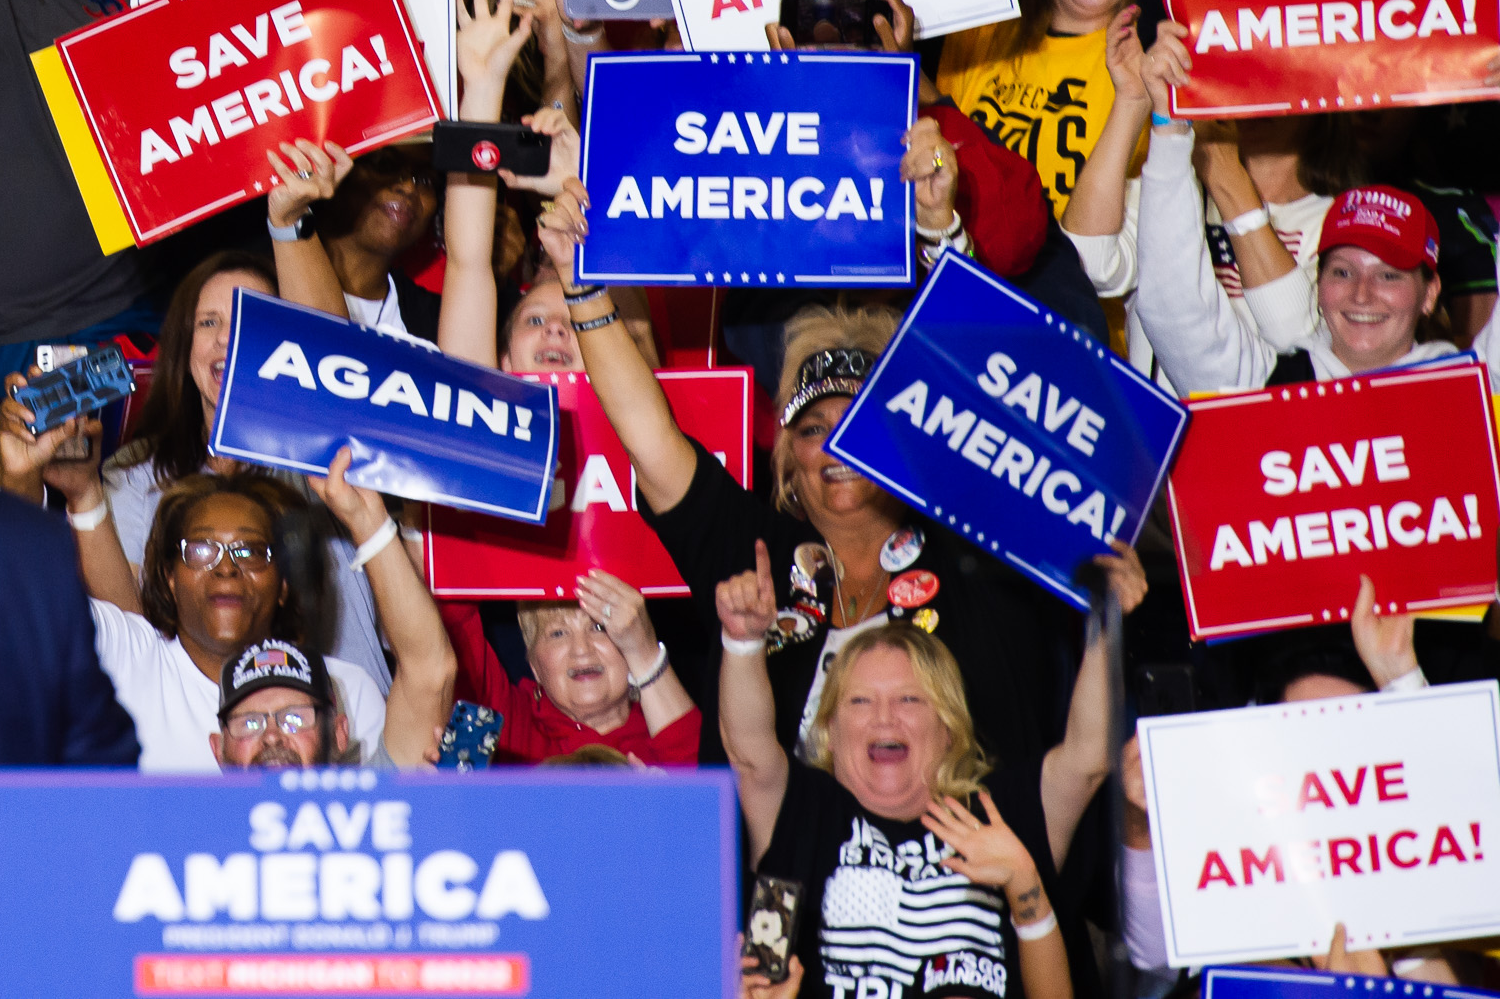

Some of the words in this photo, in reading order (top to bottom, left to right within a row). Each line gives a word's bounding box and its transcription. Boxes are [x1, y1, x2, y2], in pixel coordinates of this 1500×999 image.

[169, 0, 312, 90] SAVE
[139, 33, 395, 175] AMERICA!
[674, 111, 820, 155] SAVE
[606, 177, 885, 221] AMERICA!
[257, 339, 533, 442] AGAIN!
[977, 350, 1106, 456] SAVE
[886, 380, 1127, 545] AMERICA!
[1259, 435, 1411, 497] SAVE
[1209, 494, 1483, 572] AMERICA!
[261, 638, 312, 673] AMERICA
[273, 663, 312, 685] AGAIN
[249, 800, 413, 853] SAVE
[113, 848, 552, 924] AMERICA
